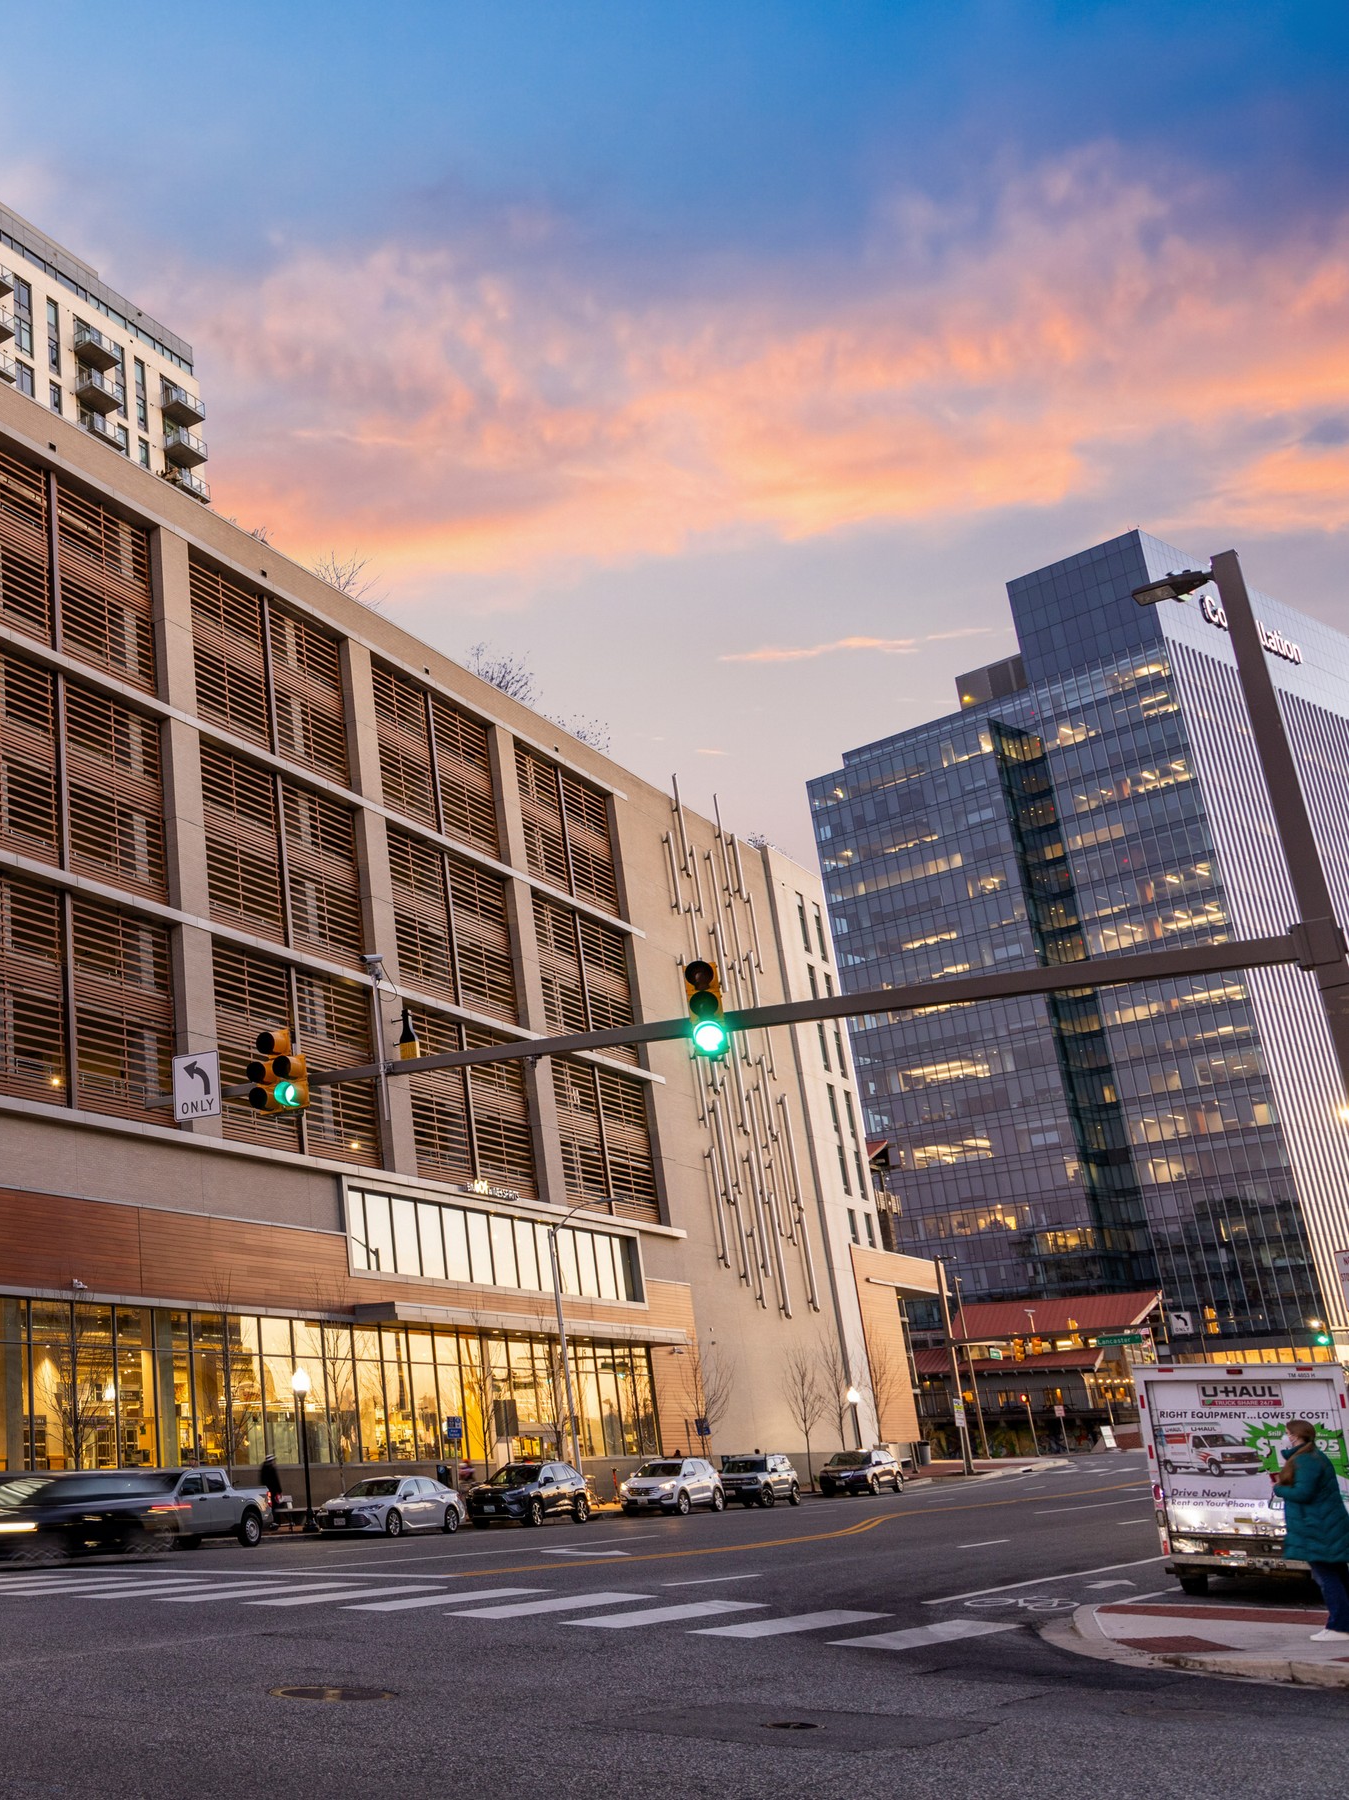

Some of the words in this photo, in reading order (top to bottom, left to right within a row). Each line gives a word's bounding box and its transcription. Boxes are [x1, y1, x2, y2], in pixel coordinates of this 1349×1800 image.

[1205, 595, 1303, 664] Collation
[181, 1098, 214, 1115] ONLY
[1097, 1337, 1131, 1345] Lancaster
[1201, 1385, 1279, 1398] U-HAUL
[1159, 1411, 1188, 1419] RIGHT
[1300, 1411, 1329, 1420] COST!
[1171, 1488, 1199, 1497] Drive
[1201, 1489, 1231, 1498] Now!
[1227, 1500, 1256, 1508] Phone
